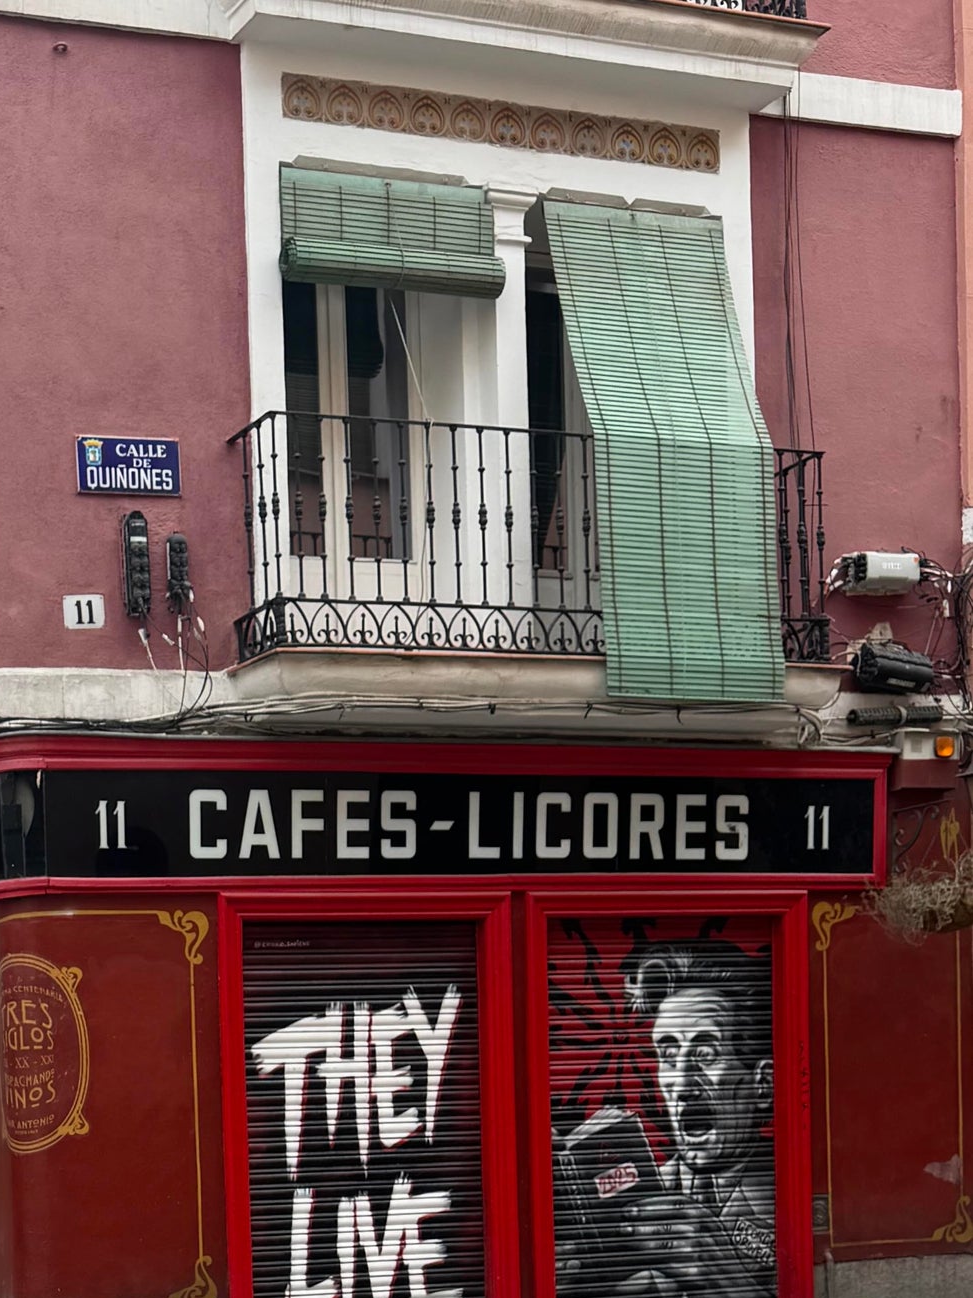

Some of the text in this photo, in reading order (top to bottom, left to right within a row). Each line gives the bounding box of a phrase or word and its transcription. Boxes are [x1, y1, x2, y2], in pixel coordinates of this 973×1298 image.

[115, 443, 167, 458] CALLE
[133, 458, 151, 468] DE
[86, 464, 173, 490] QUIÑONES
[75, 599, 96, 625] 11
[95, 800, 128, 849] 11
[804, 805, 830, 850] 11
[4, 1026, 55, 1050] IGLOS
[250, 983, 462, 1182] THEY
[16, 1113, 55, 1129] ANTONIO
